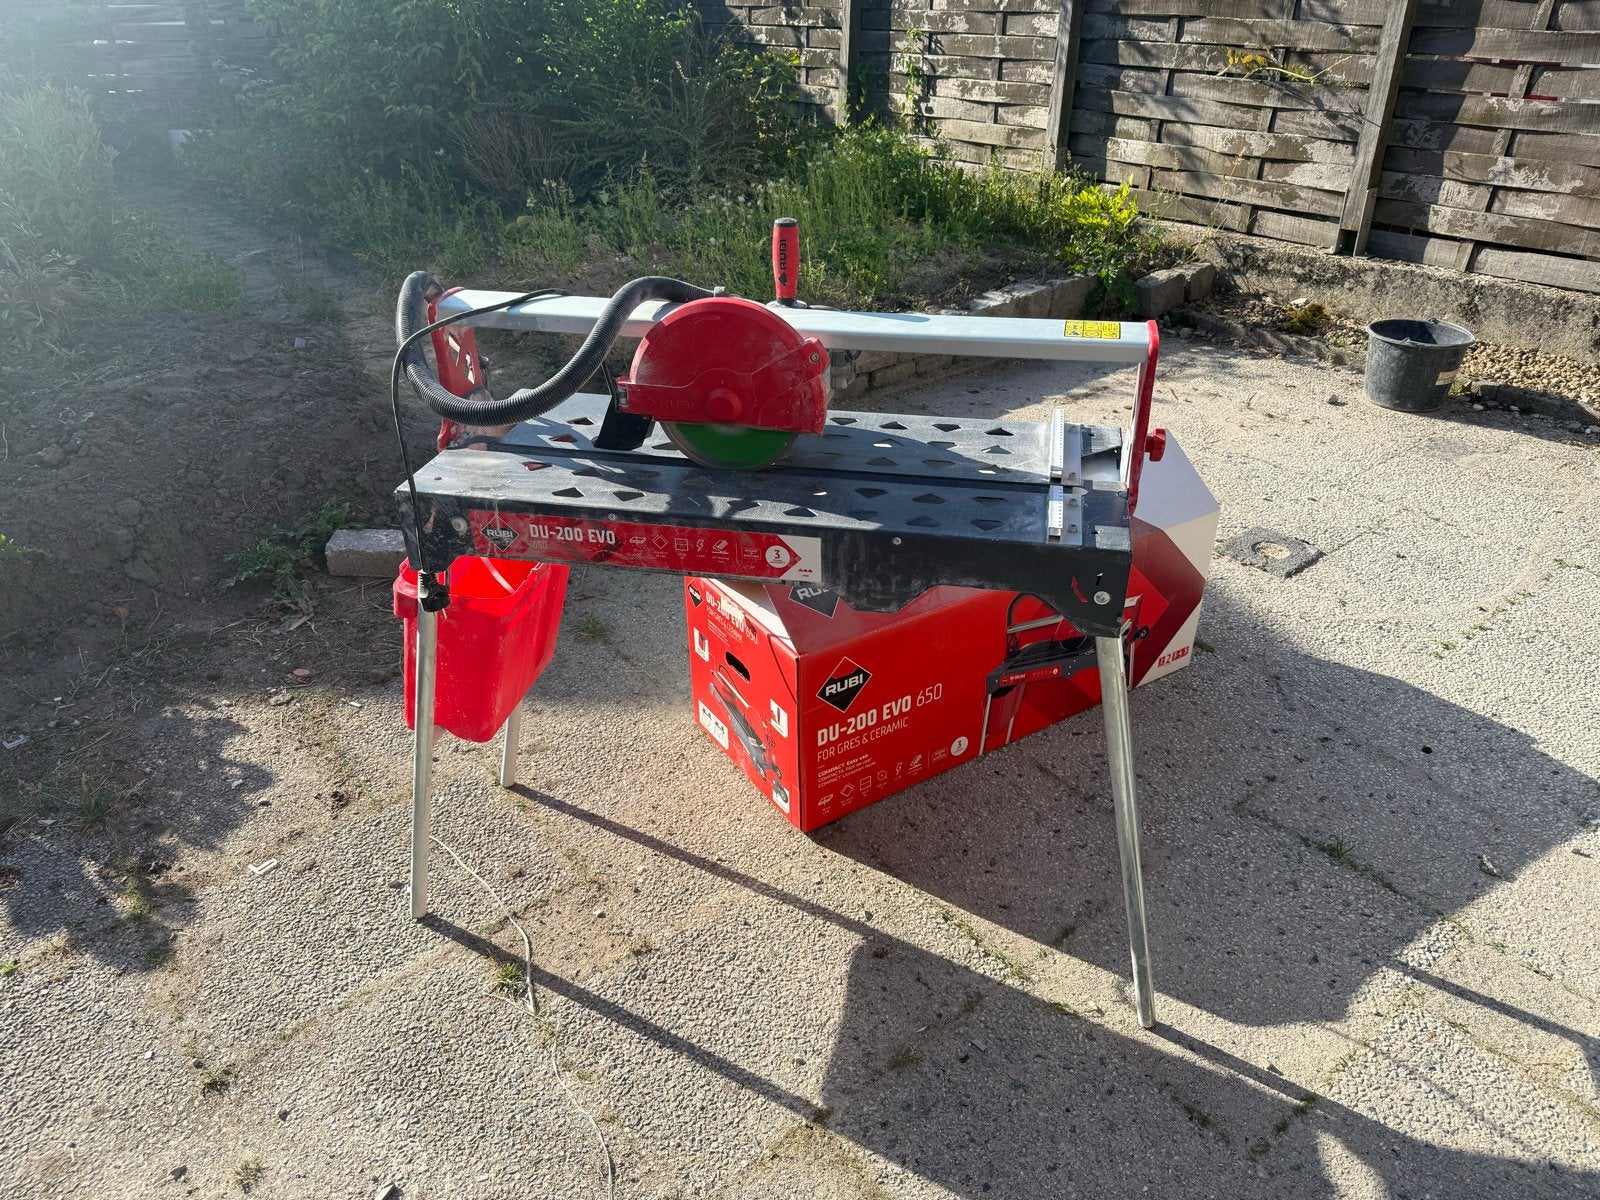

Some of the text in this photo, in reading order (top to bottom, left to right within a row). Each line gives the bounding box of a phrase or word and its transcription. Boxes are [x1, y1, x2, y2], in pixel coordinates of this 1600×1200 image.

[779, 239, 787, 270] RUBI
[486, 528, 514, 539] RUBI
[529, 524, 616, 546] DU-200 EVO
[774, 549, 781, 559] 3
[796, 587, 830, 601] RU
[825, 673, 864, 697] RUBI
[817, 683, 943, 747] DU-200 EVO 650
[817, 716, 909, 763] FOR GRES & CERAMIC
